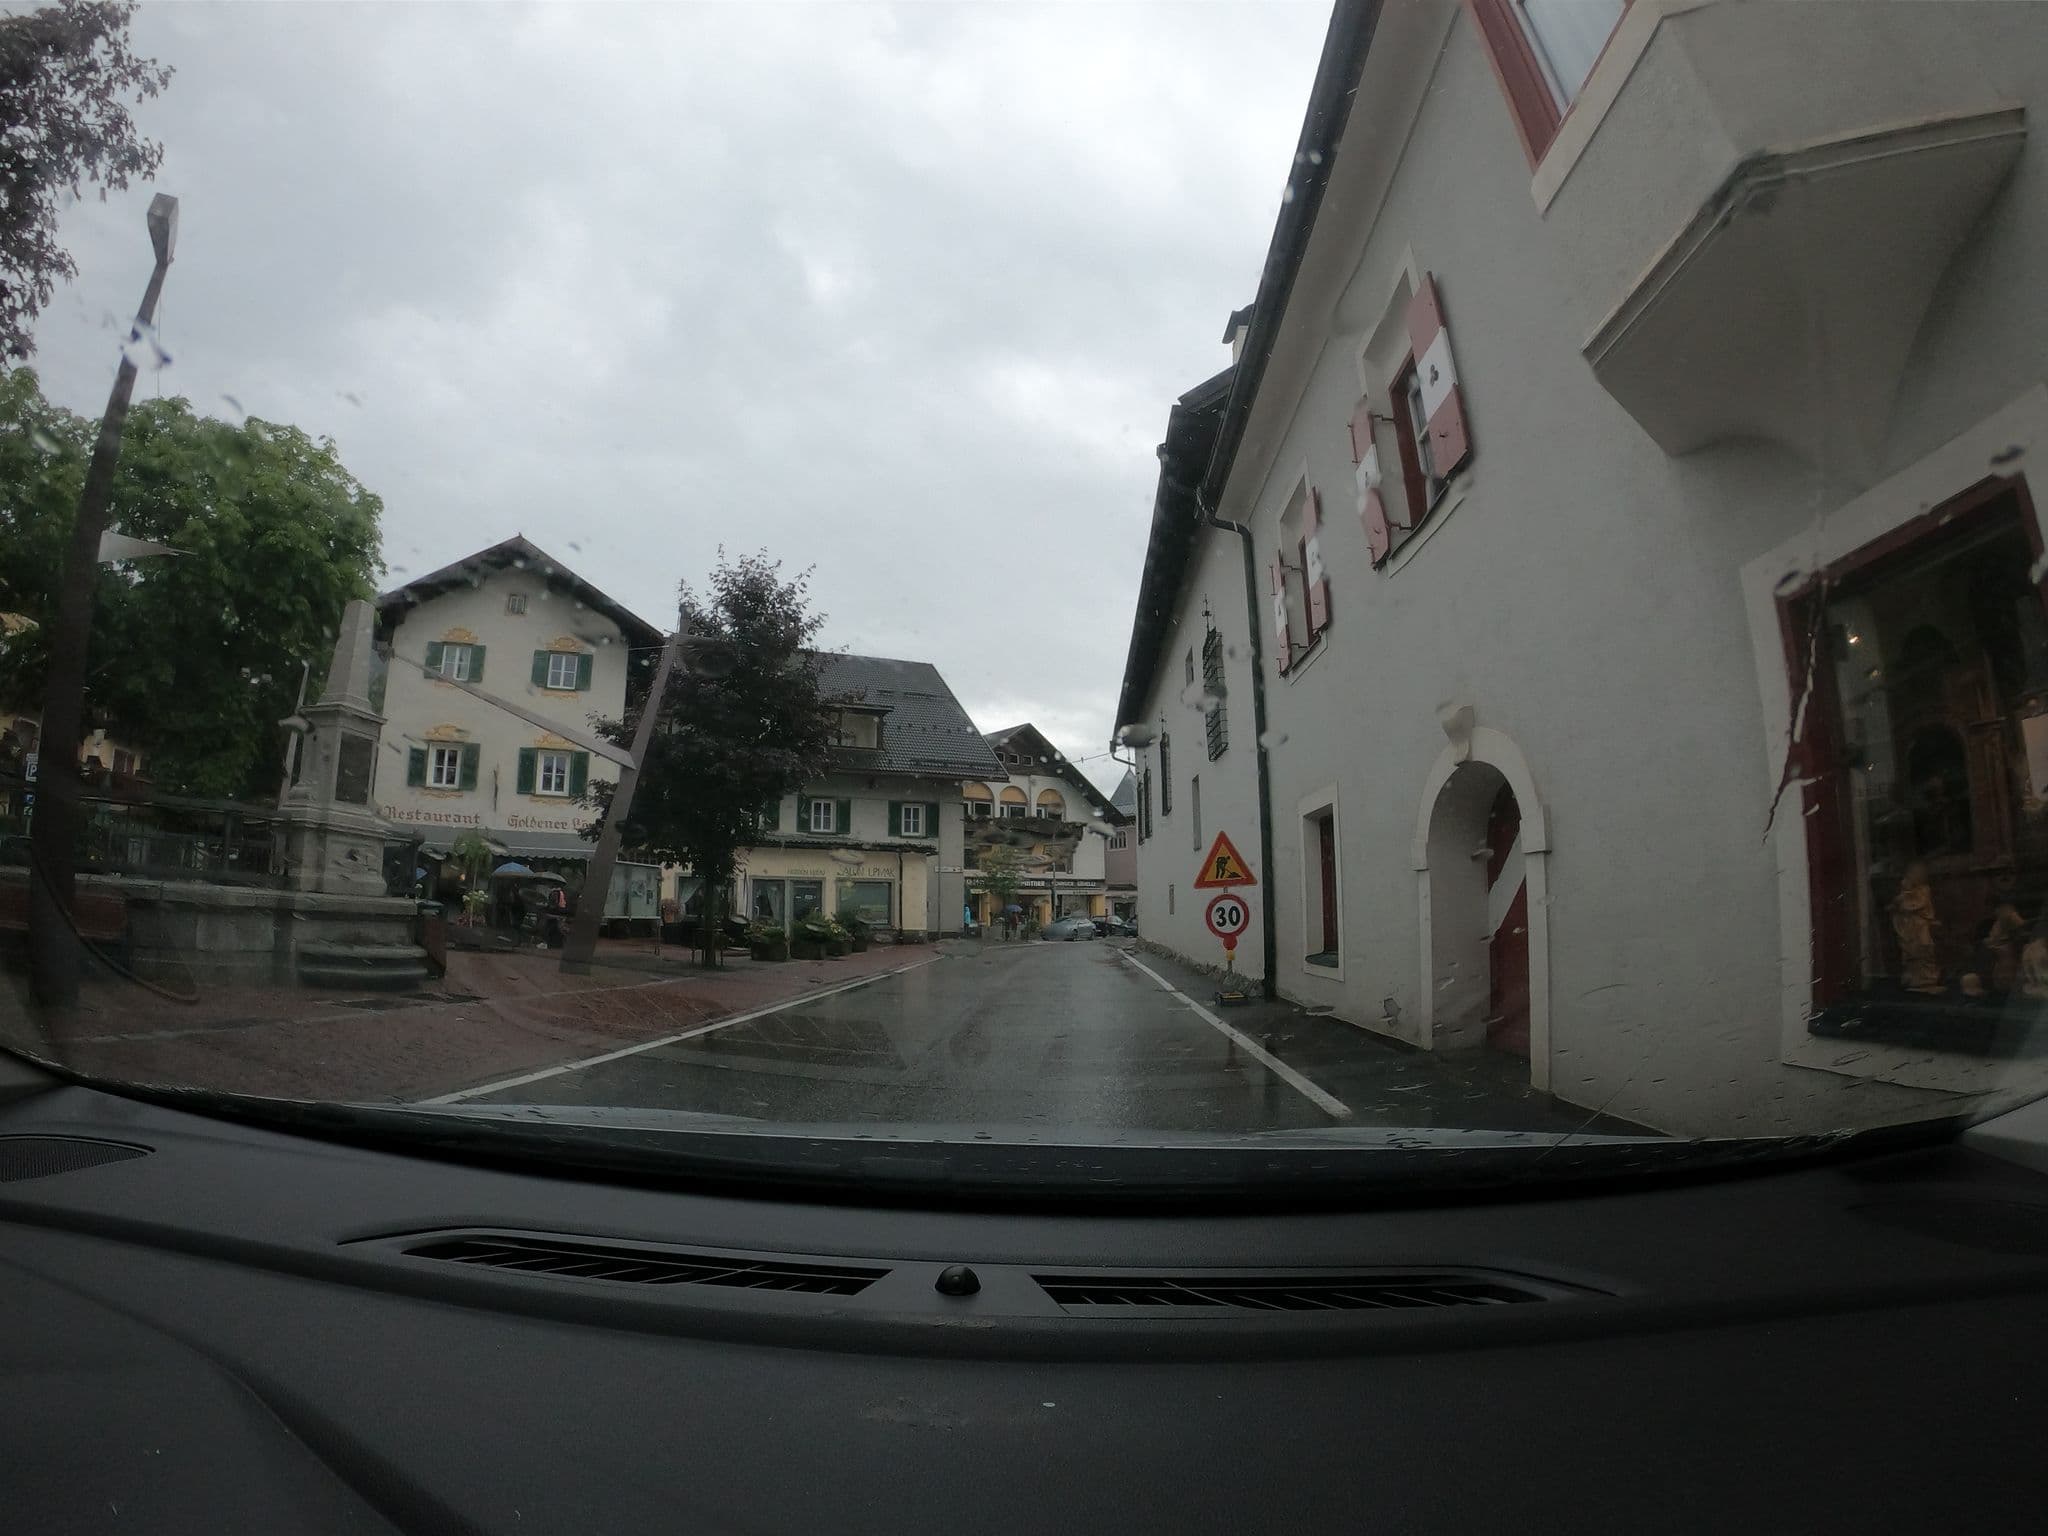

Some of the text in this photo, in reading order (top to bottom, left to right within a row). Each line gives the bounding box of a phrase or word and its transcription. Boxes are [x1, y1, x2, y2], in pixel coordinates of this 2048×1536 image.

[384, 806, 481, 824] Restaurant
[508, 814, 568, 830] Goldener
[1215, 905, 1241, 928] 30
